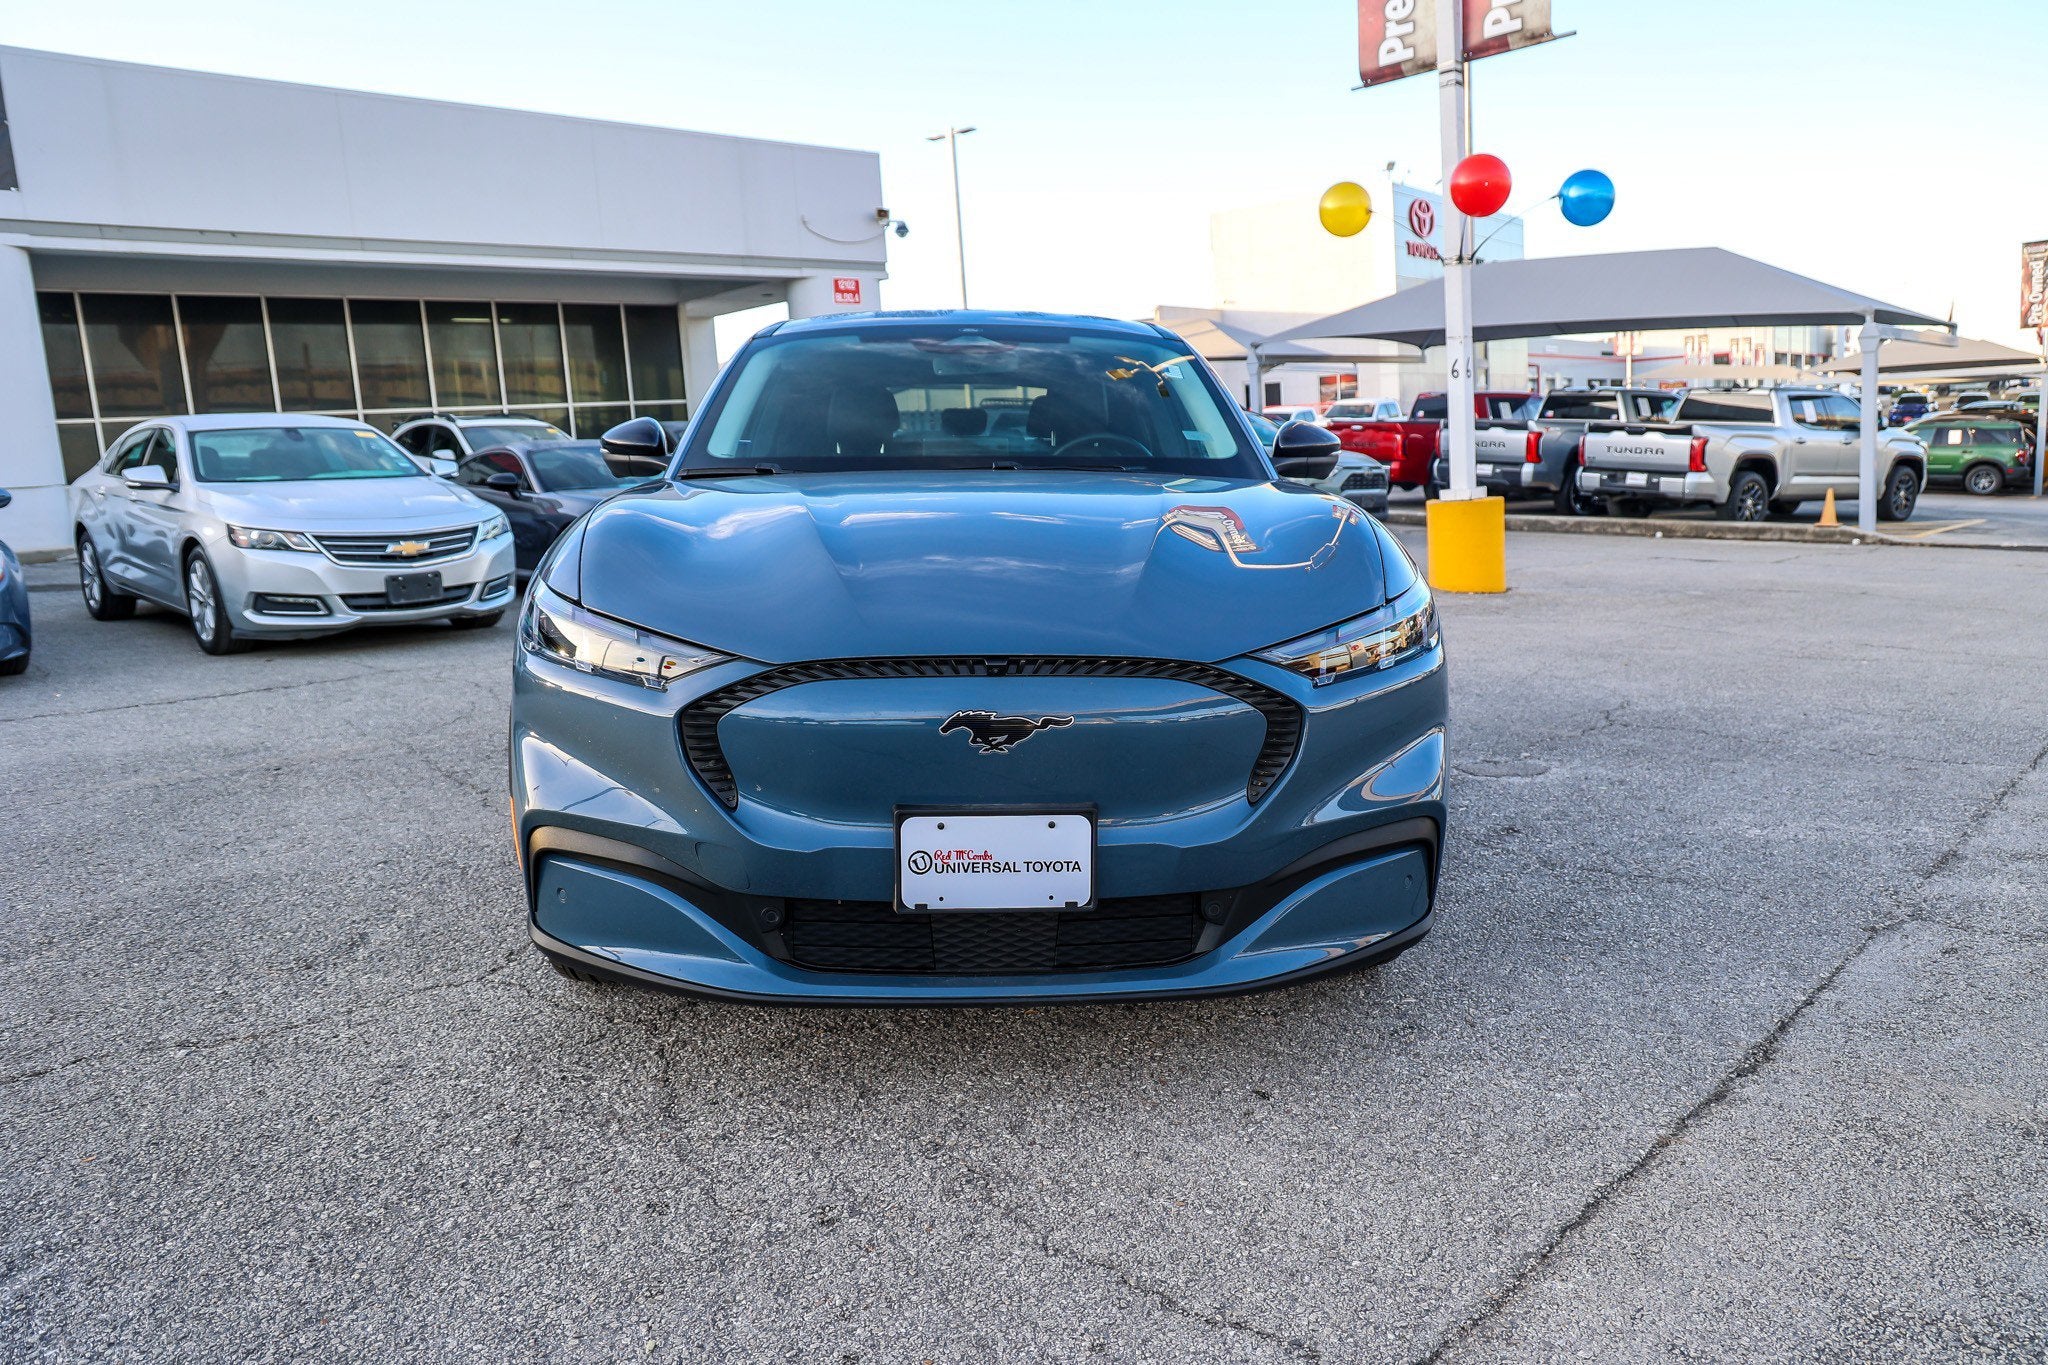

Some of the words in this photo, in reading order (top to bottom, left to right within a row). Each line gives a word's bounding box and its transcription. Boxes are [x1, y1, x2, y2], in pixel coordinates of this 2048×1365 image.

[1605, 445, 1665, 456] TUNDRA
[934, 850, 952, 865] Red
[934, 861, 1021, 874] UNIVERSAL
[1023, 860, 1082, 873] TOYOTA
